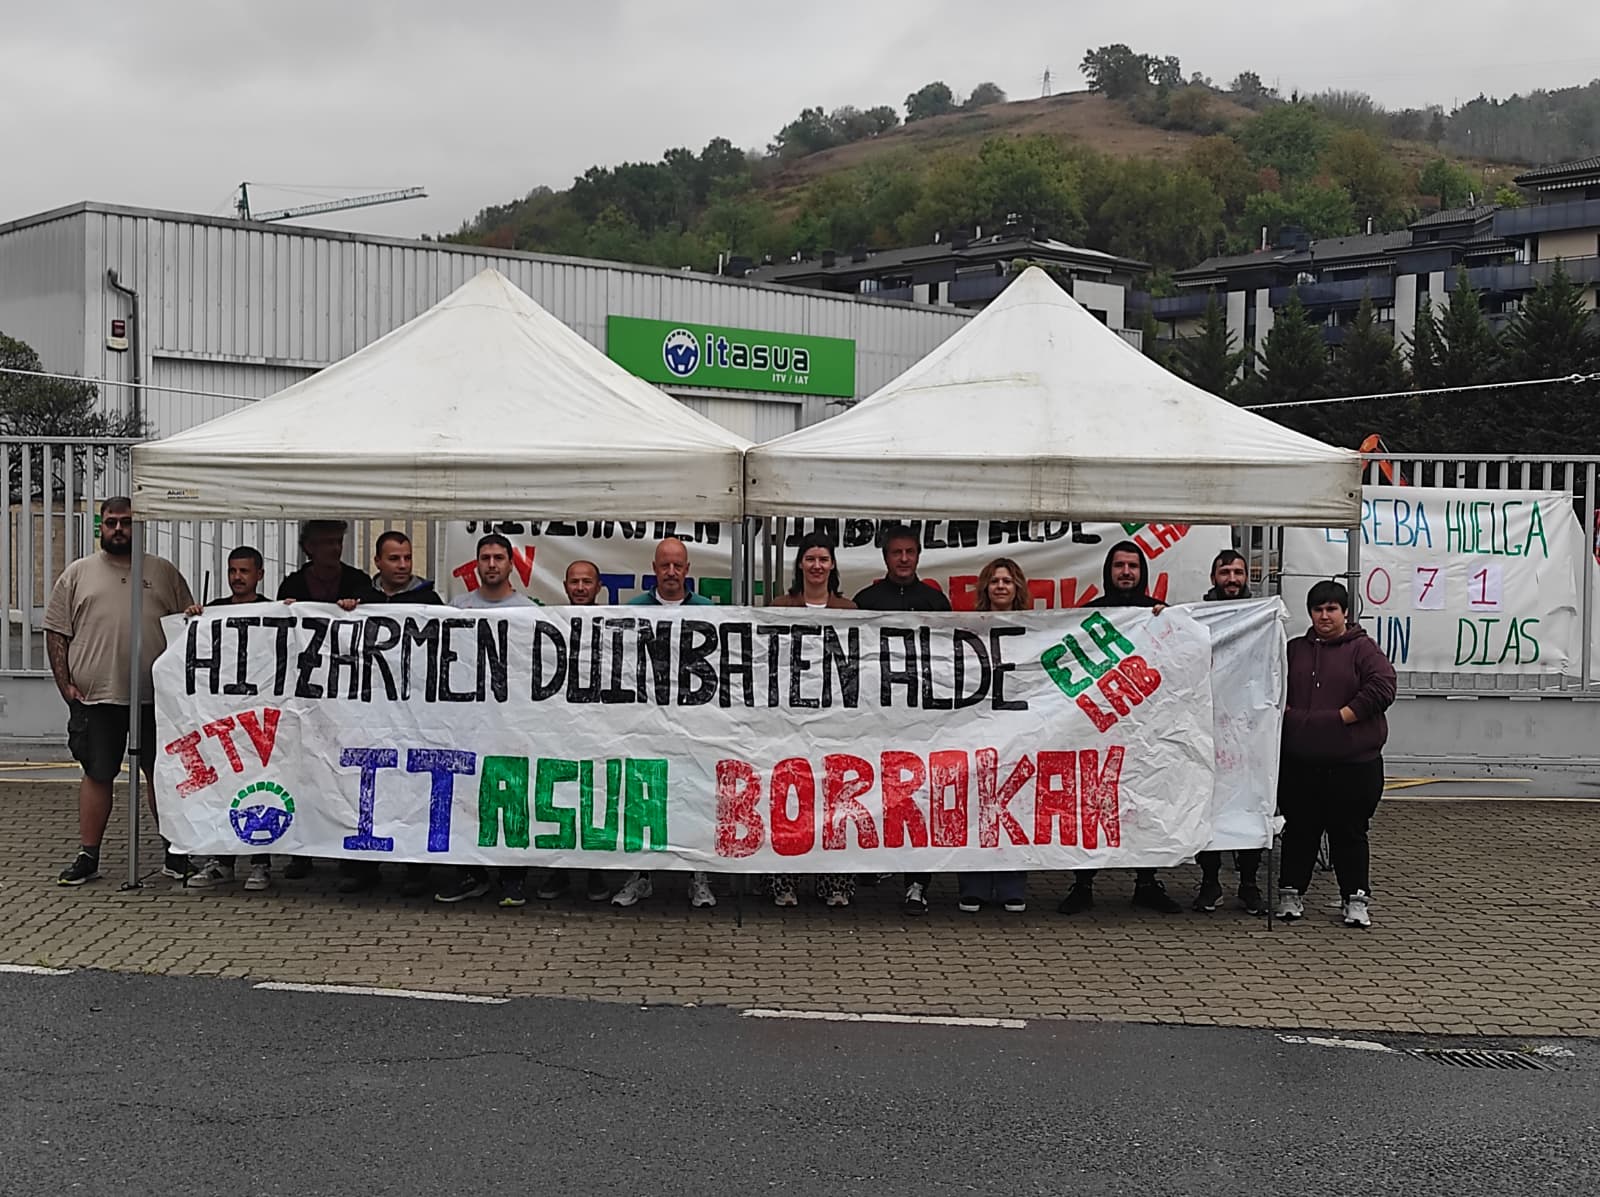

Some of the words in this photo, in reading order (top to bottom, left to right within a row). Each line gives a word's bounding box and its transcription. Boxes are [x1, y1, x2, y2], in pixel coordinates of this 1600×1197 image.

[705, 333, 810, 373] itasua
[772, 373, 787, 383] ITV
[794, 375, 809, 385] IAT
[1446, 500, 1548, 558] HUELGA
[185, 616, 509, 703] HITZARMEN
[879, 626, 1029, 710] ALDE
[1040, 611, 1135, 697] ELA
[1454, 617, 1541, 666] DIAS
[1075, 655, 1161, 732] LAB
[164, 707, 281, 798] ITV
[339, 747, 669, 854] ITASUA
[715, 745, 1126, 858] BORROKAK
